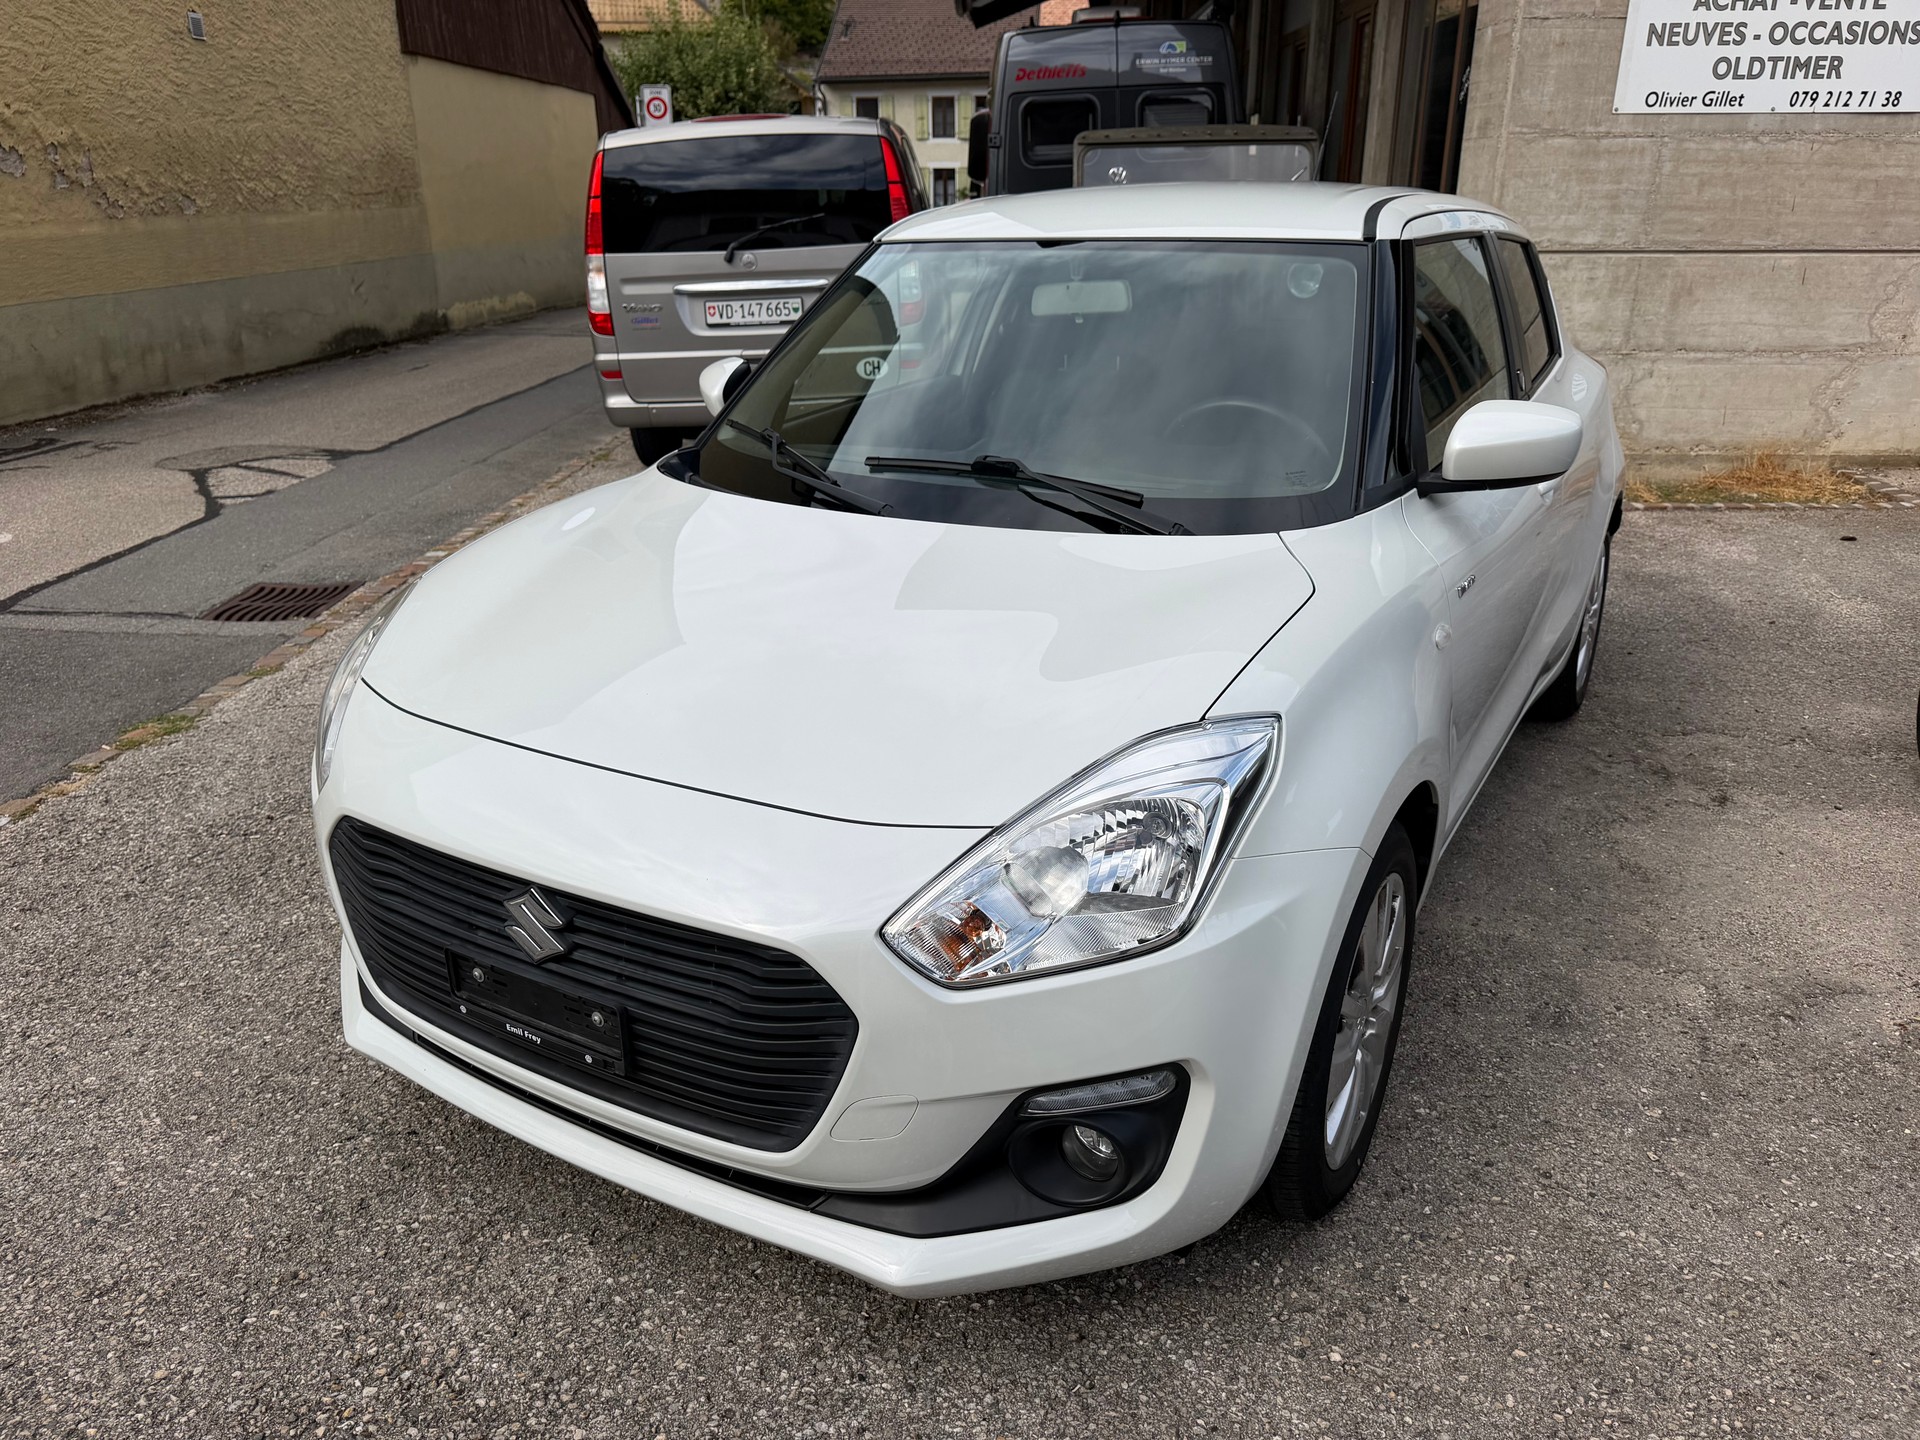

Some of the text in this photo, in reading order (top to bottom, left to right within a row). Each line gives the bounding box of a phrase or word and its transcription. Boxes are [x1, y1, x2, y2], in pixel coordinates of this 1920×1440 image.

[1646, 22, 1748, 46] NEUVES
[1768, 20, 1920, 45] OCCASIONS
[1712, 55, 1844, 80] OLDTIMER
[1645, 91, 1903, 108] Olivier Gillet 079 212 71 38
[864, 360, 881, 377] CH
[506, 1023, 541, 1045] Emil Frey
